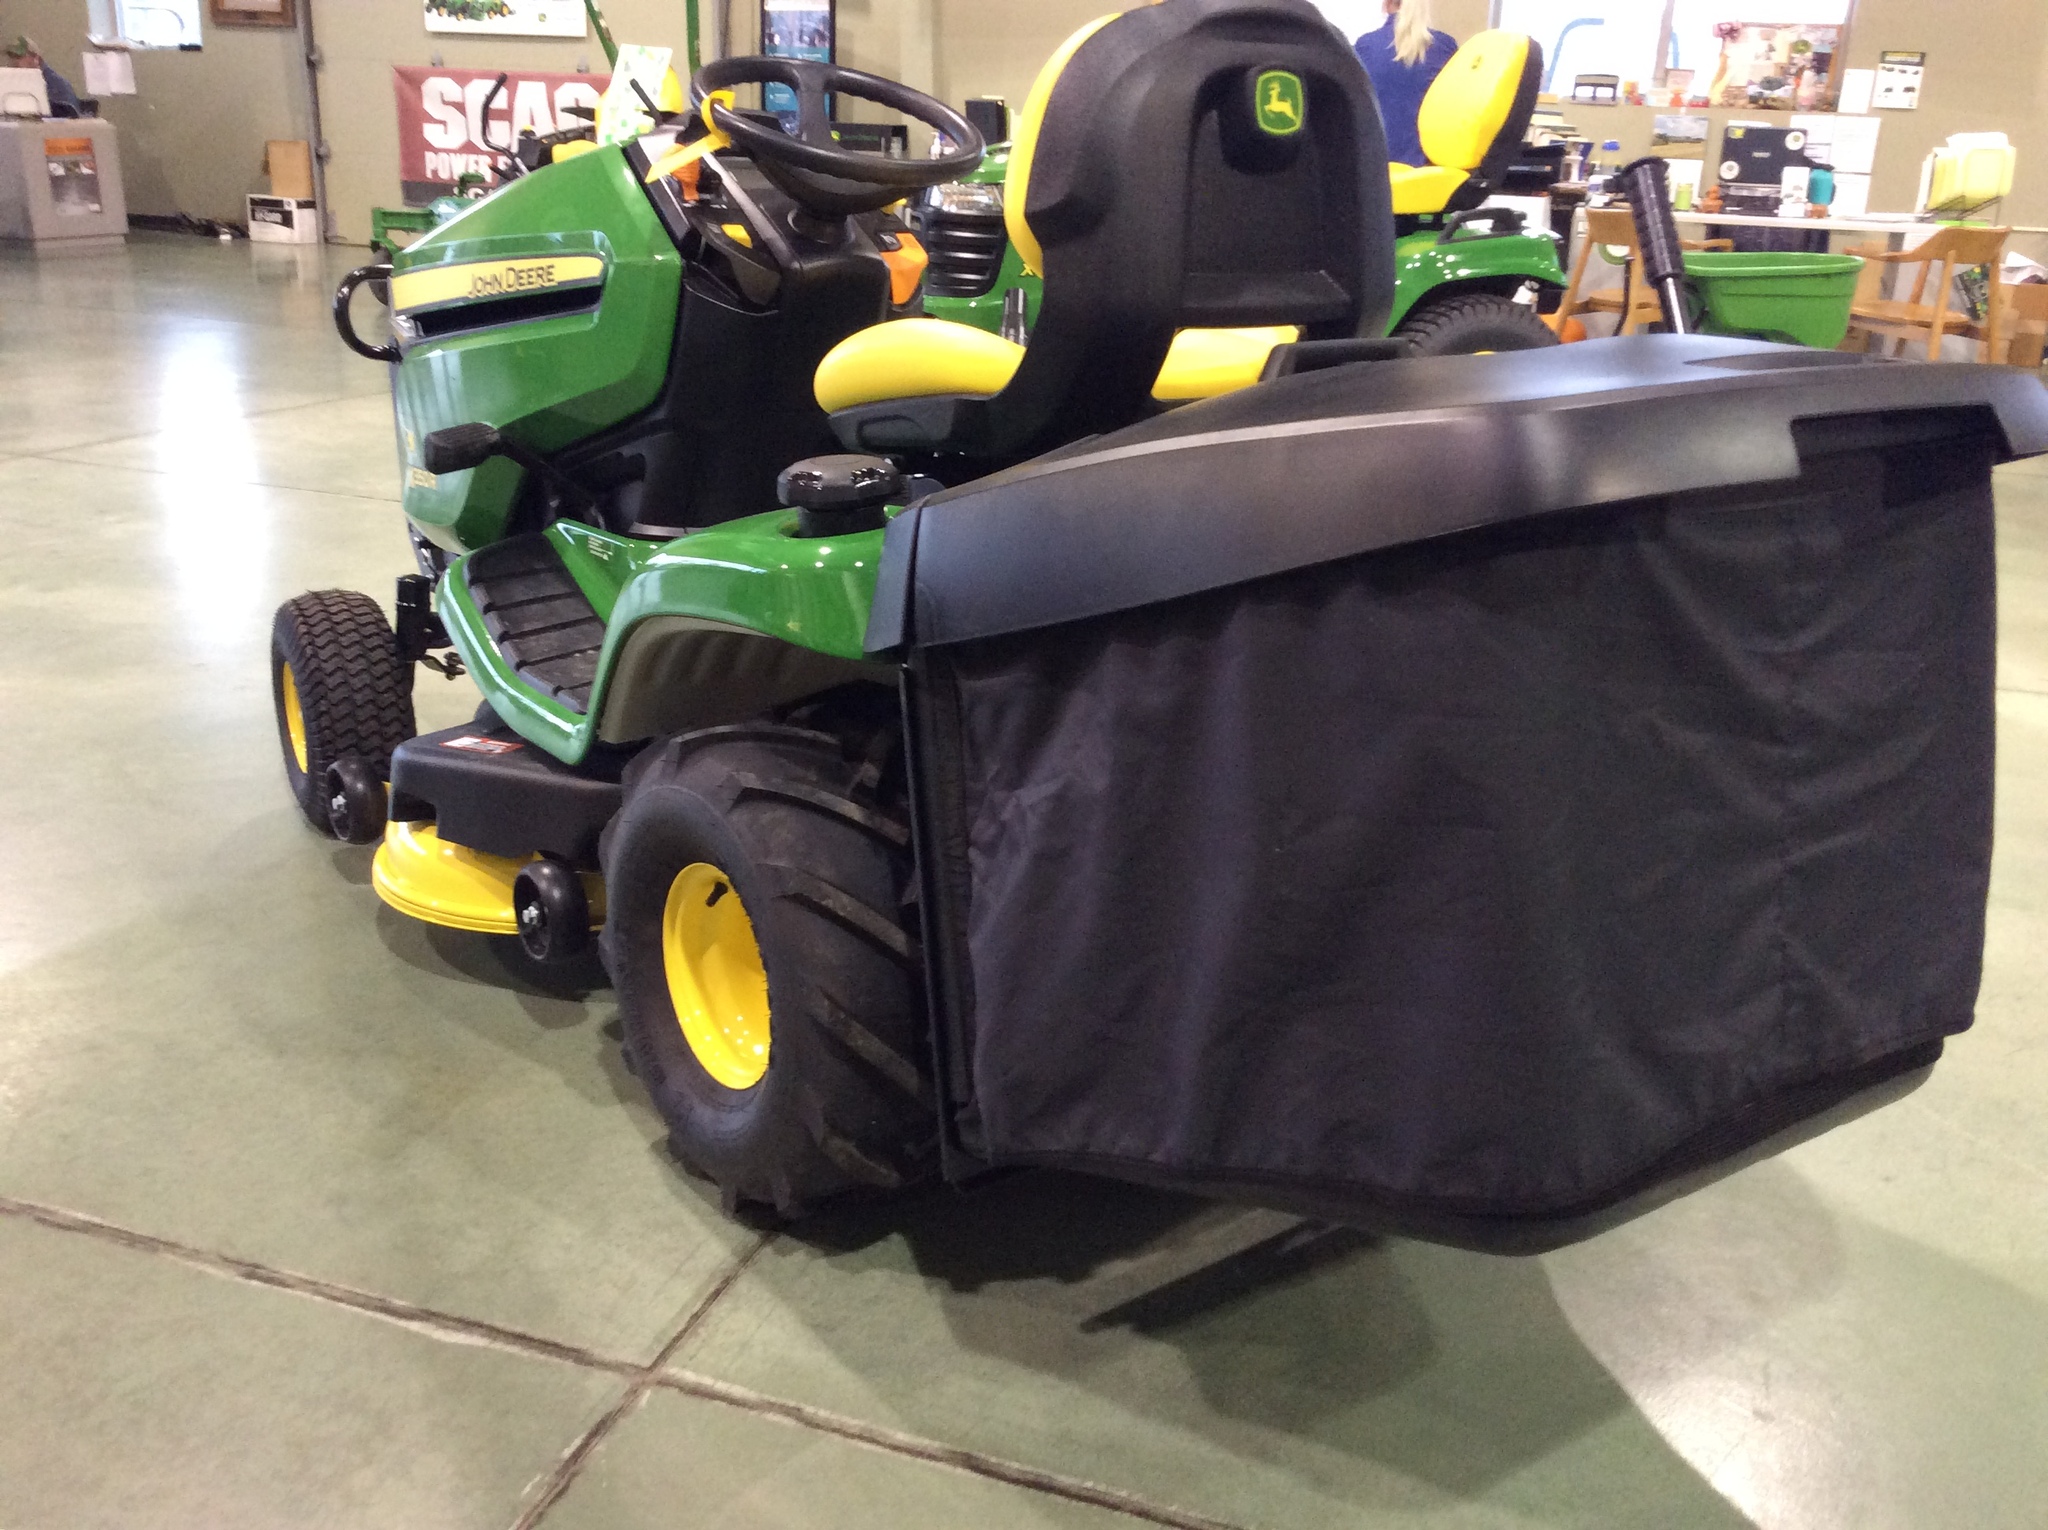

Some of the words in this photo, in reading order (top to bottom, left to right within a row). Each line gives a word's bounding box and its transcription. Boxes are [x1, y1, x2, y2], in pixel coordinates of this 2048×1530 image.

[424, 151, 493, 183] POWER
[467, 272, 504, 296] JOHN
[505, 264, 556, 290] DEERE
